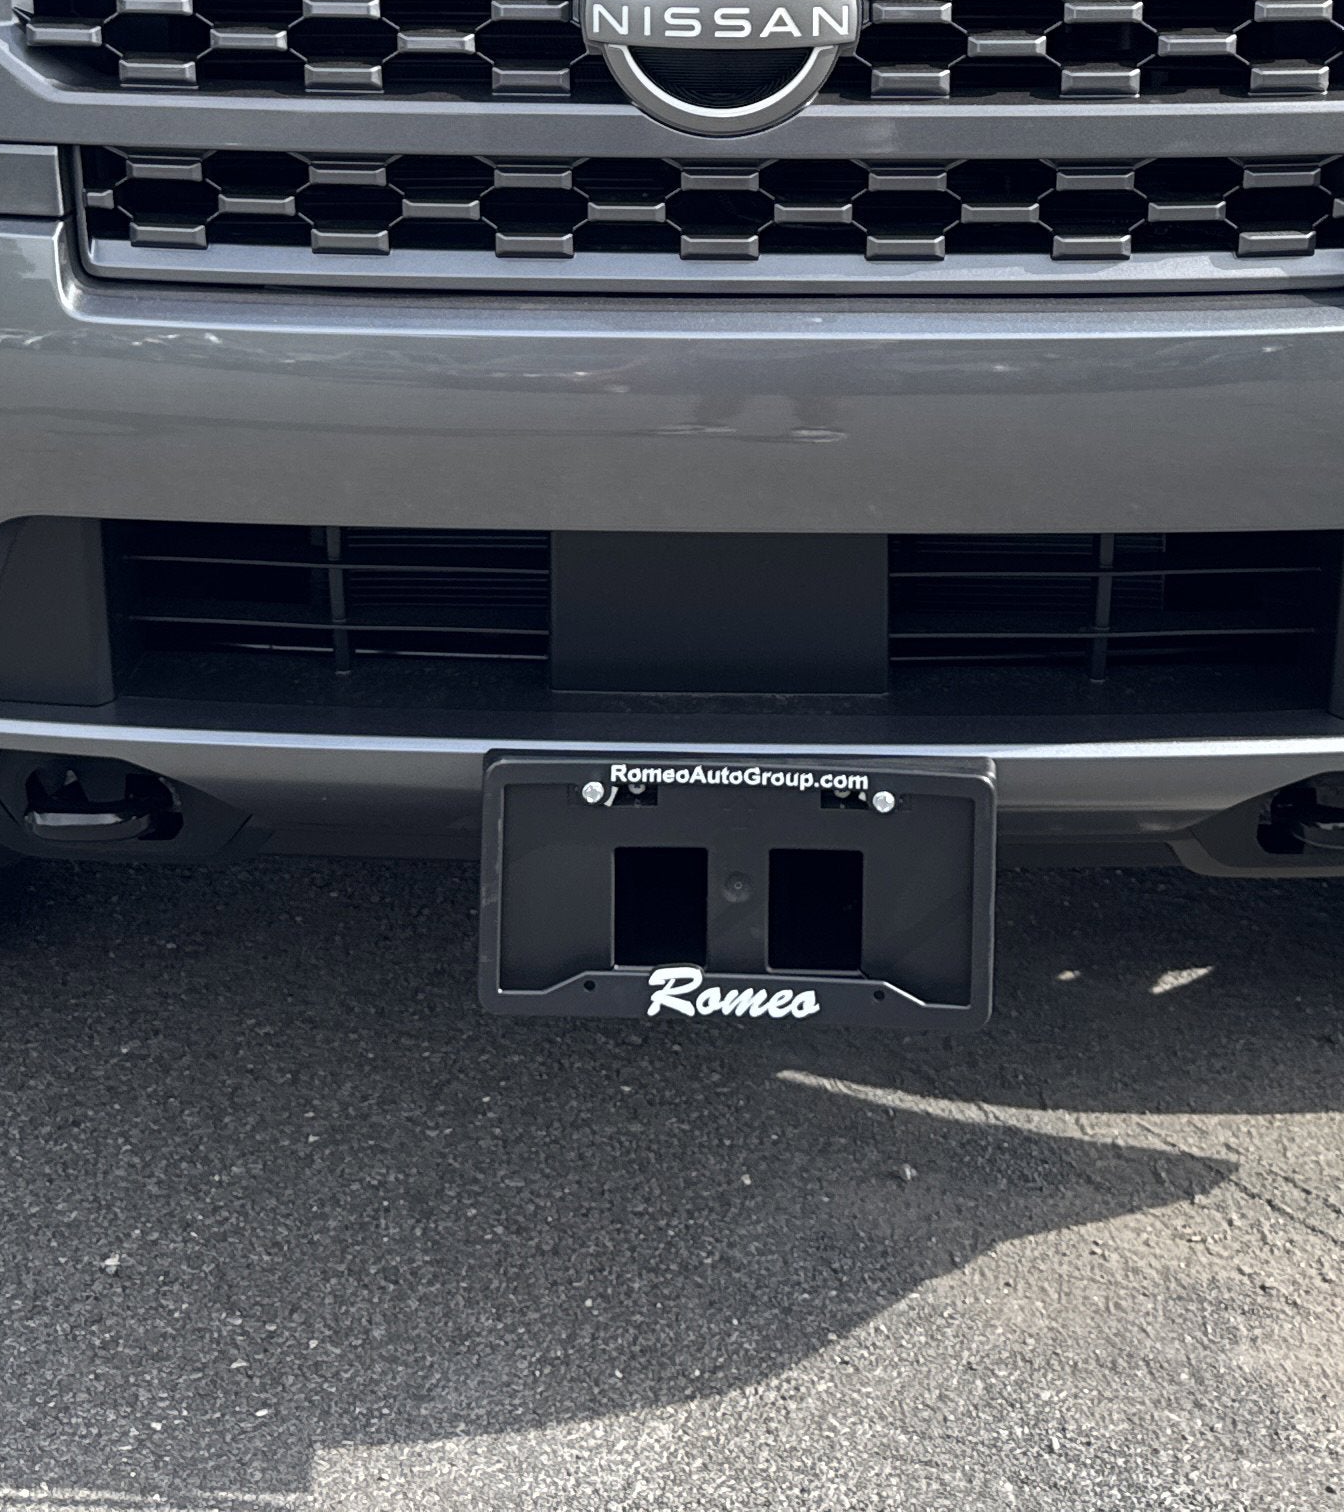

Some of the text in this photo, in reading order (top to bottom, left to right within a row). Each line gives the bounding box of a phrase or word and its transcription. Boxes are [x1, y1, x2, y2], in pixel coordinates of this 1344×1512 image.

[592, 3, 850, 38] NISSAN
[609, 763, 869, 791] RomeoAutoGroup.com
[646, 966, 821, 1019] Romeo
